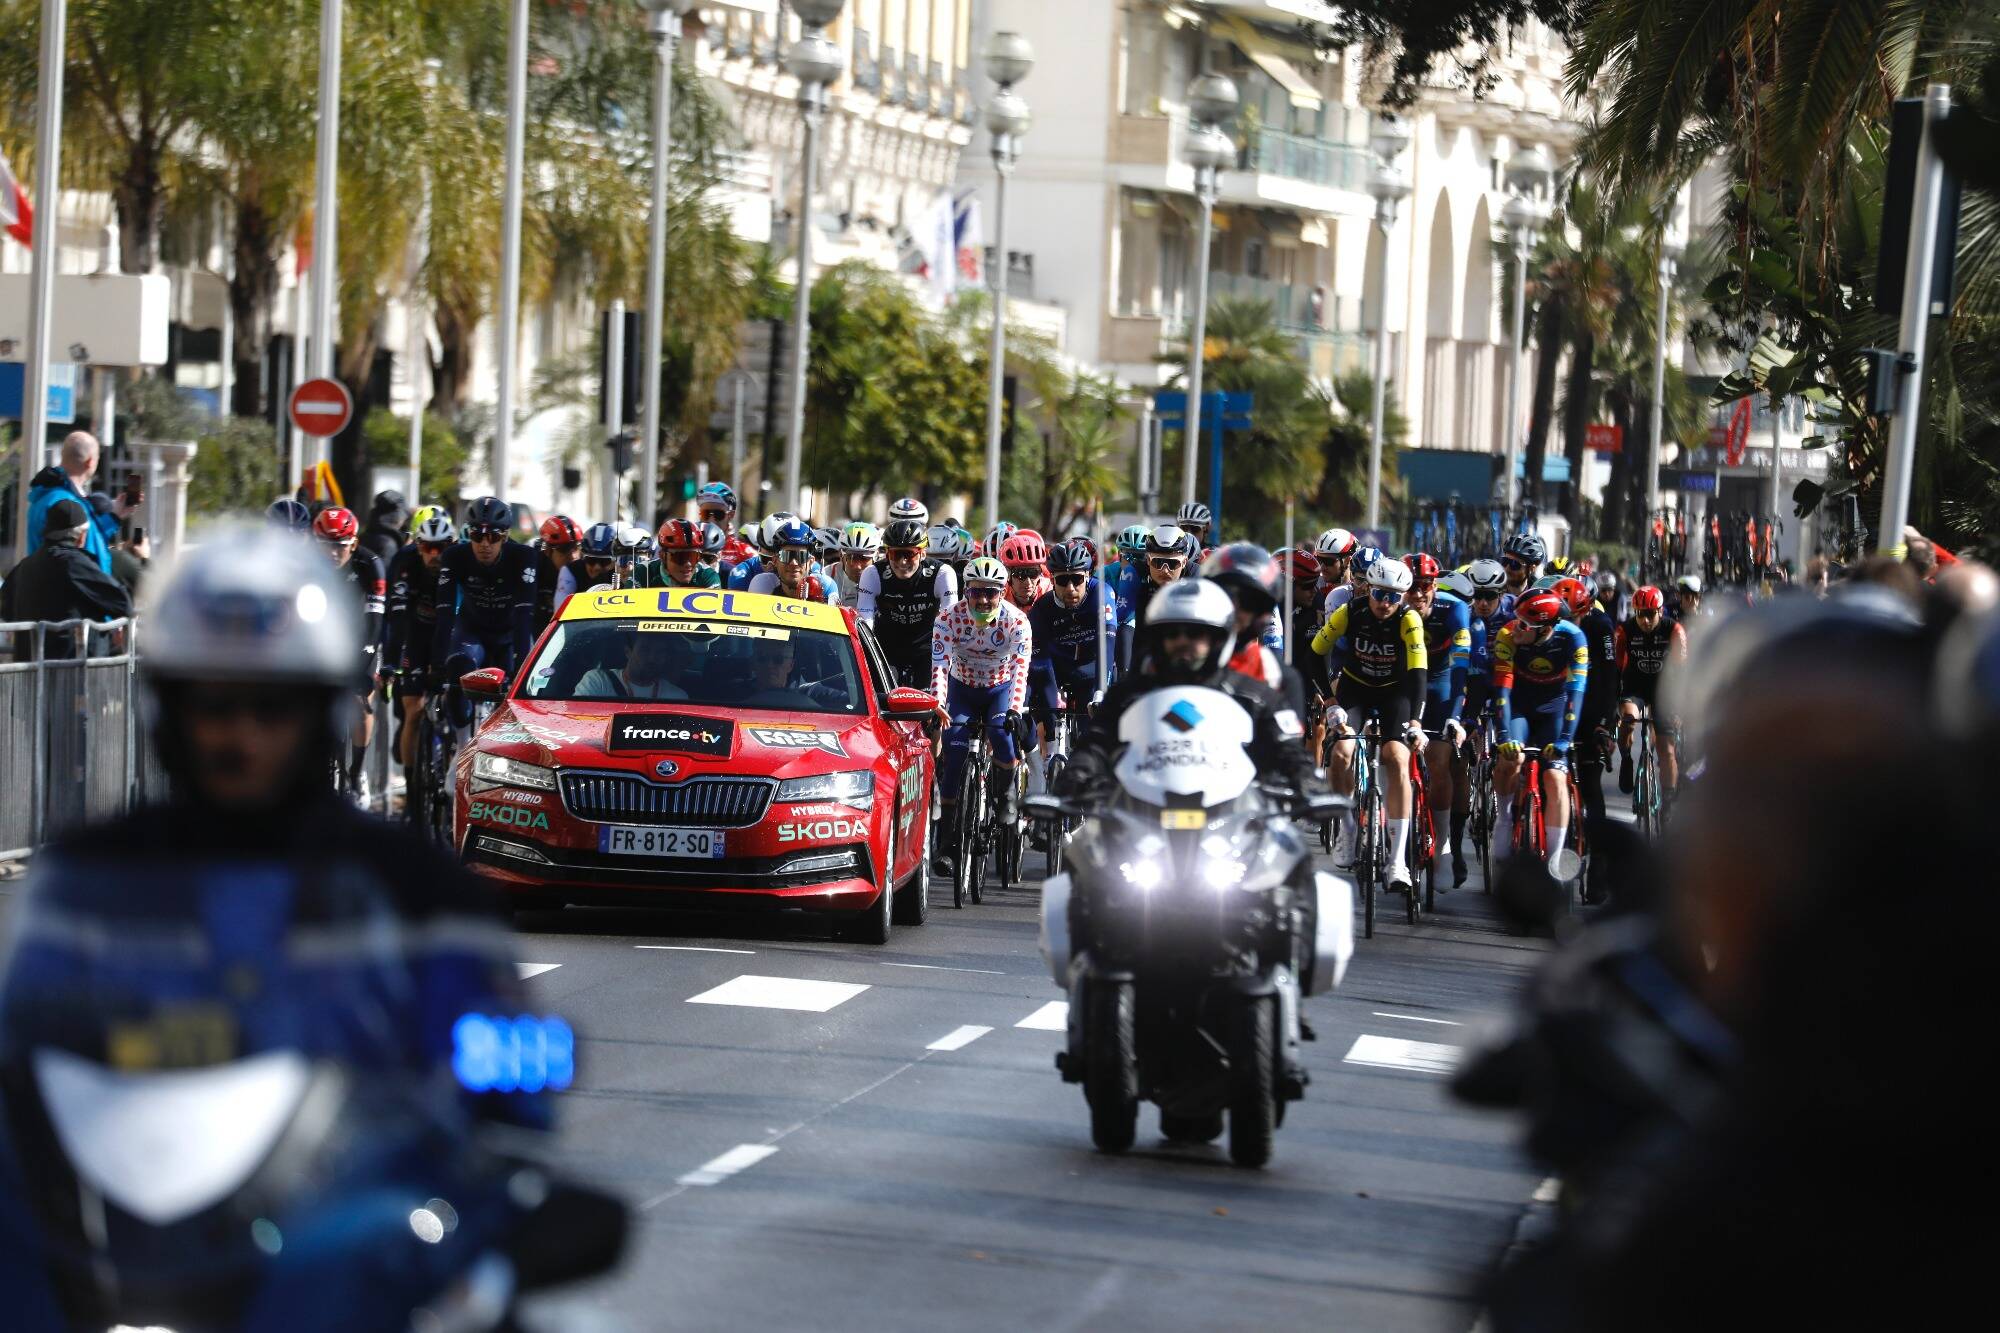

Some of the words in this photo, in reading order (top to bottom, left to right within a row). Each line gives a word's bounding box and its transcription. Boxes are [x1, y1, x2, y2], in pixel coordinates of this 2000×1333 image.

[597, 595, 636, 606] LCL
[657, 591, 750, 617] LCL
[776, 602, 815, 617] LCL
[642, 622, 694, 632] OFFICIEL
[757, 628, 767, 637] 1
[1355, 637, 1396, 656] UAE
[502, 791, 543, 804] HYBRID
[790, 805, 834, 817] HYBRID
[612, 829, 710, 854] FR-812-SQ
[713, 844, 725, 855] 92
